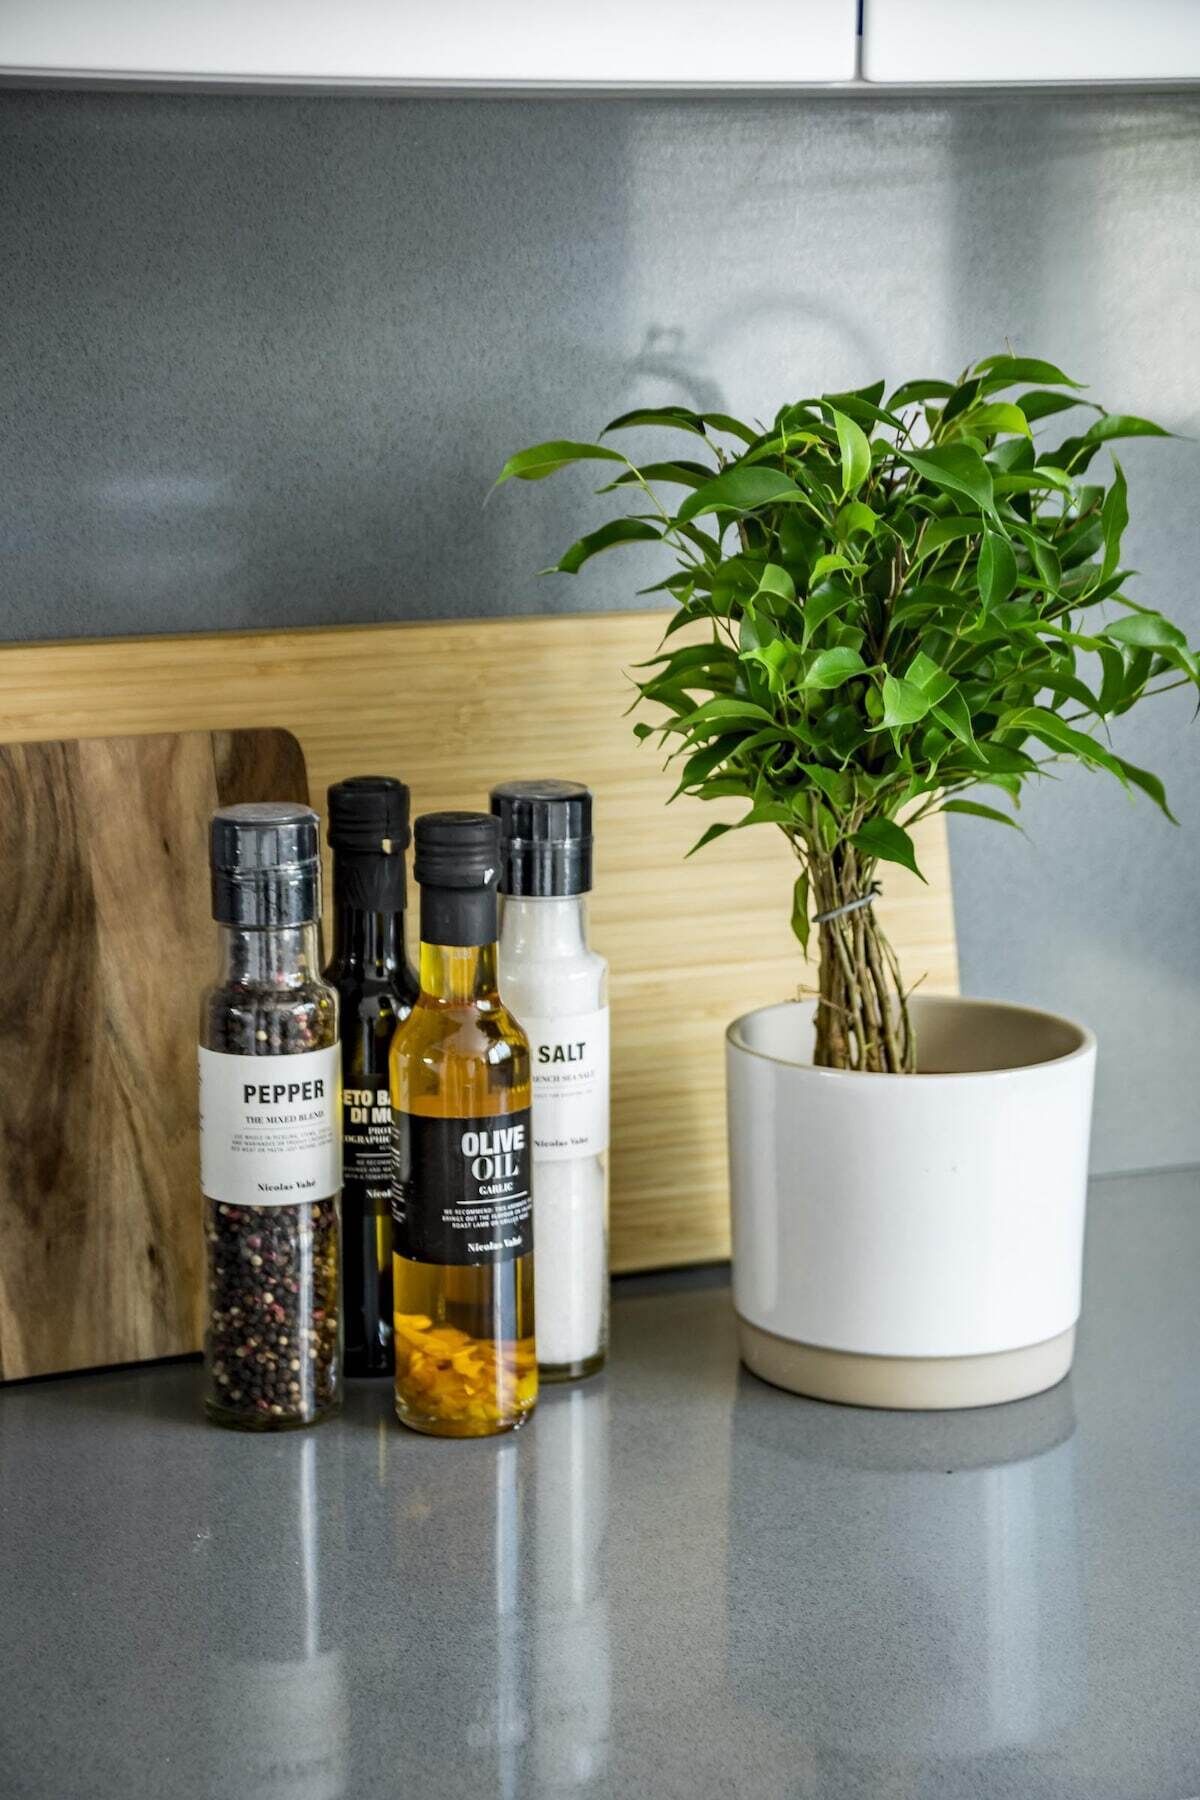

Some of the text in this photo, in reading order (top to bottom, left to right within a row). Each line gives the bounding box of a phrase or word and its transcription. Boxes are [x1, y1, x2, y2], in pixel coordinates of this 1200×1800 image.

[537, 1042, 586, 1064] SALT
[243, 1078, 324, 1104] PEPPER
[246, 1109, 324, 1124] THE MIXED BLEND
[350, 1107, 368, 1124] DI
[461, 1124, 525, 1157] OLIVE
[471, 1153, 519, 1181] OIL
[257, 1183, 293, 1191] Nicolas
[478, 1181, 513, 1195] GARLIC
[472, 1220, 489, 1228] LAMB
[478, 1213, 489, 1221] THE
[467, 1241, 503, 1252] Nicolas
